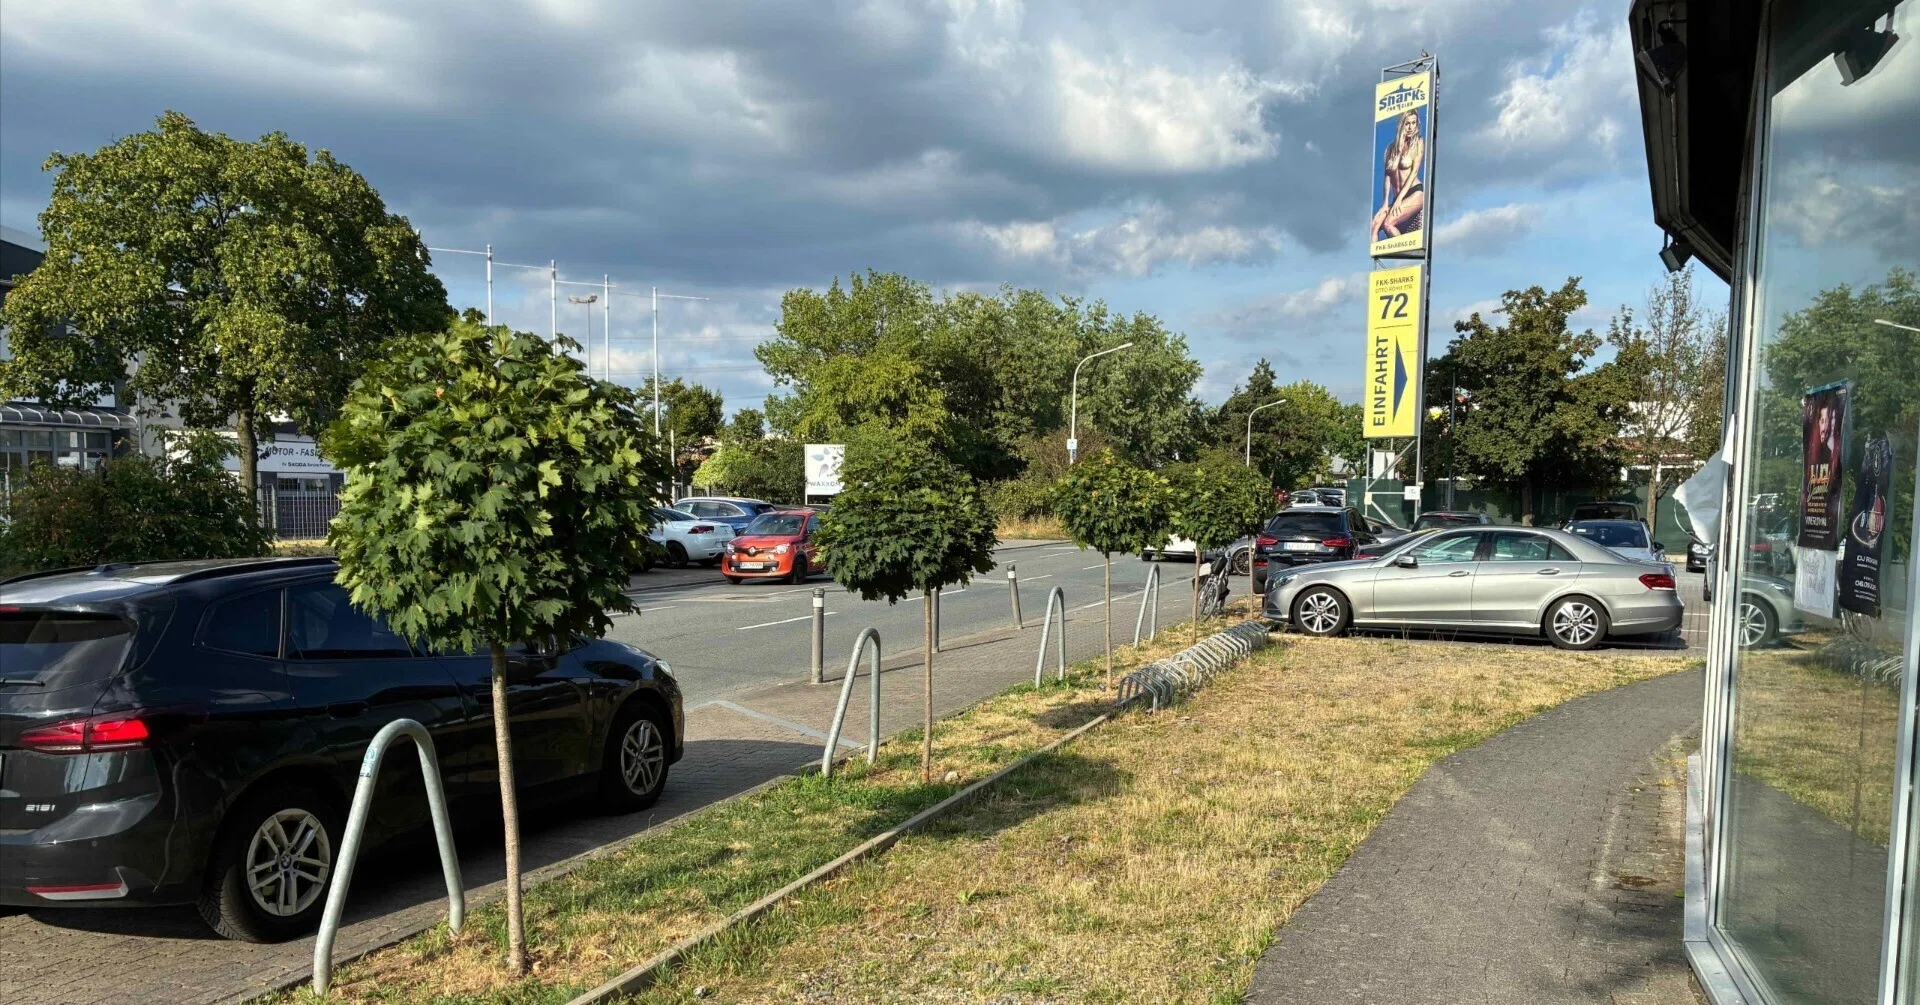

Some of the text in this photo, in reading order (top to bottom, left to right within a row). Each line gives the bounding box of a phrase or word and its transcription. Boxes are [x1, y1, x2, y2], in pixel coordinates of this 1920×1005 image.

[1375, 275, 1414, 287] FKK-SHARKS
[1379, 292, 1409, 320] 72
[1373, 335, 1389, 427] EINFAHRT
